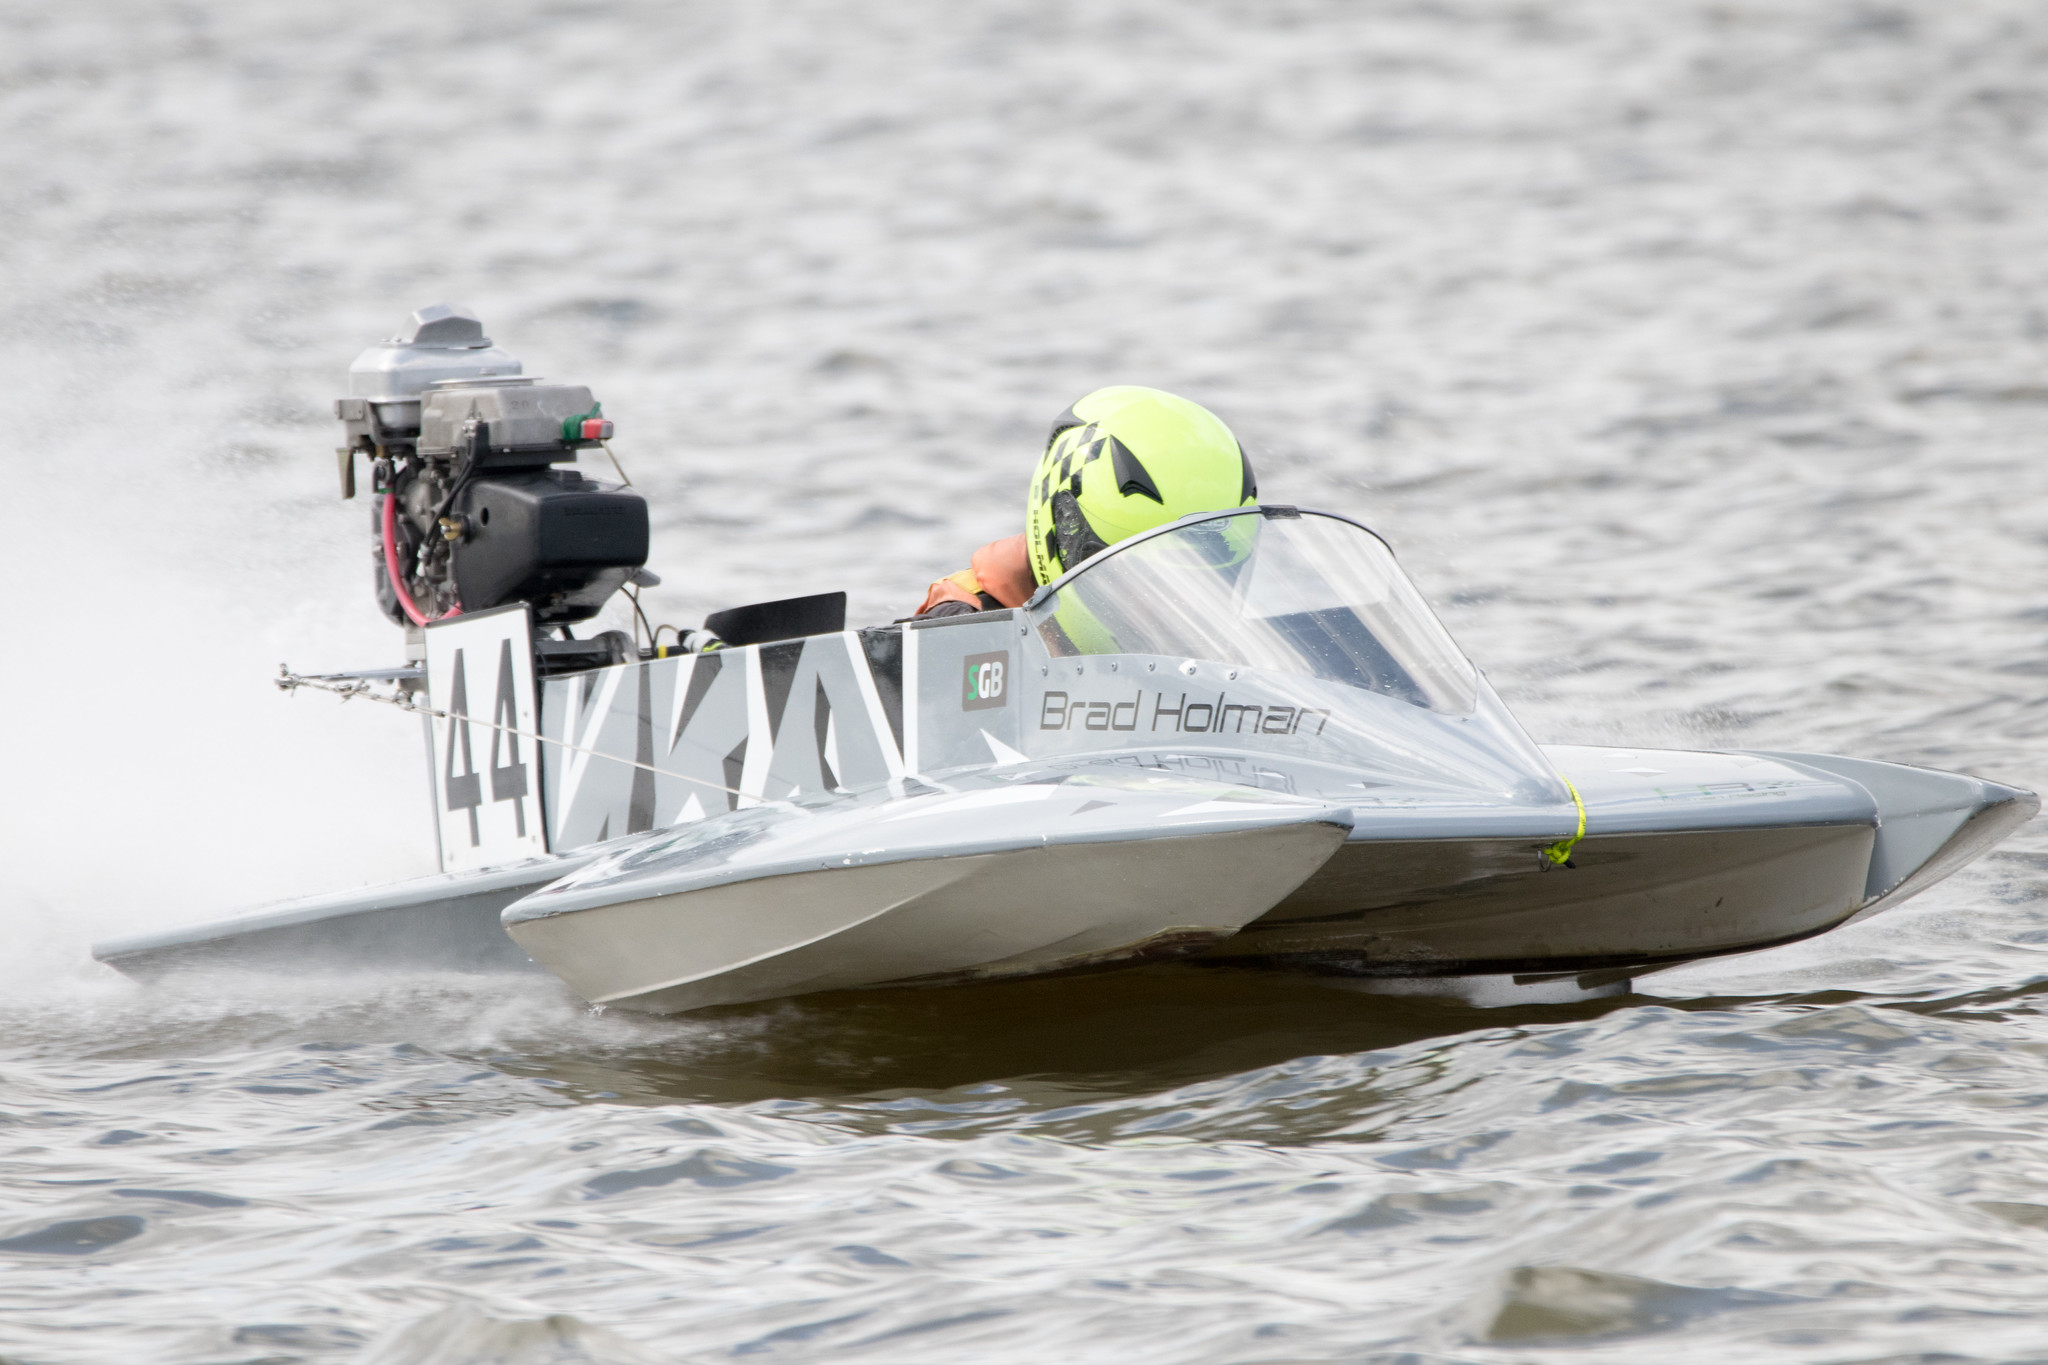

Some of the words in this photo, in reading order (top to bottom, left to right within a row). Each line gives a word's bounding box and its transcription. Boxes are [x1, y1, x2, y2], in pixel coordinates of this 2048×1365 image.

[1033, 509, 1051, 586] HOLMA
[967, 661, 1004, 701] SGB
[445, 637, 528, 848] 44
[1039, 689, 1142, 731] Brad
[1152, 691, 1332, 736] Holman
